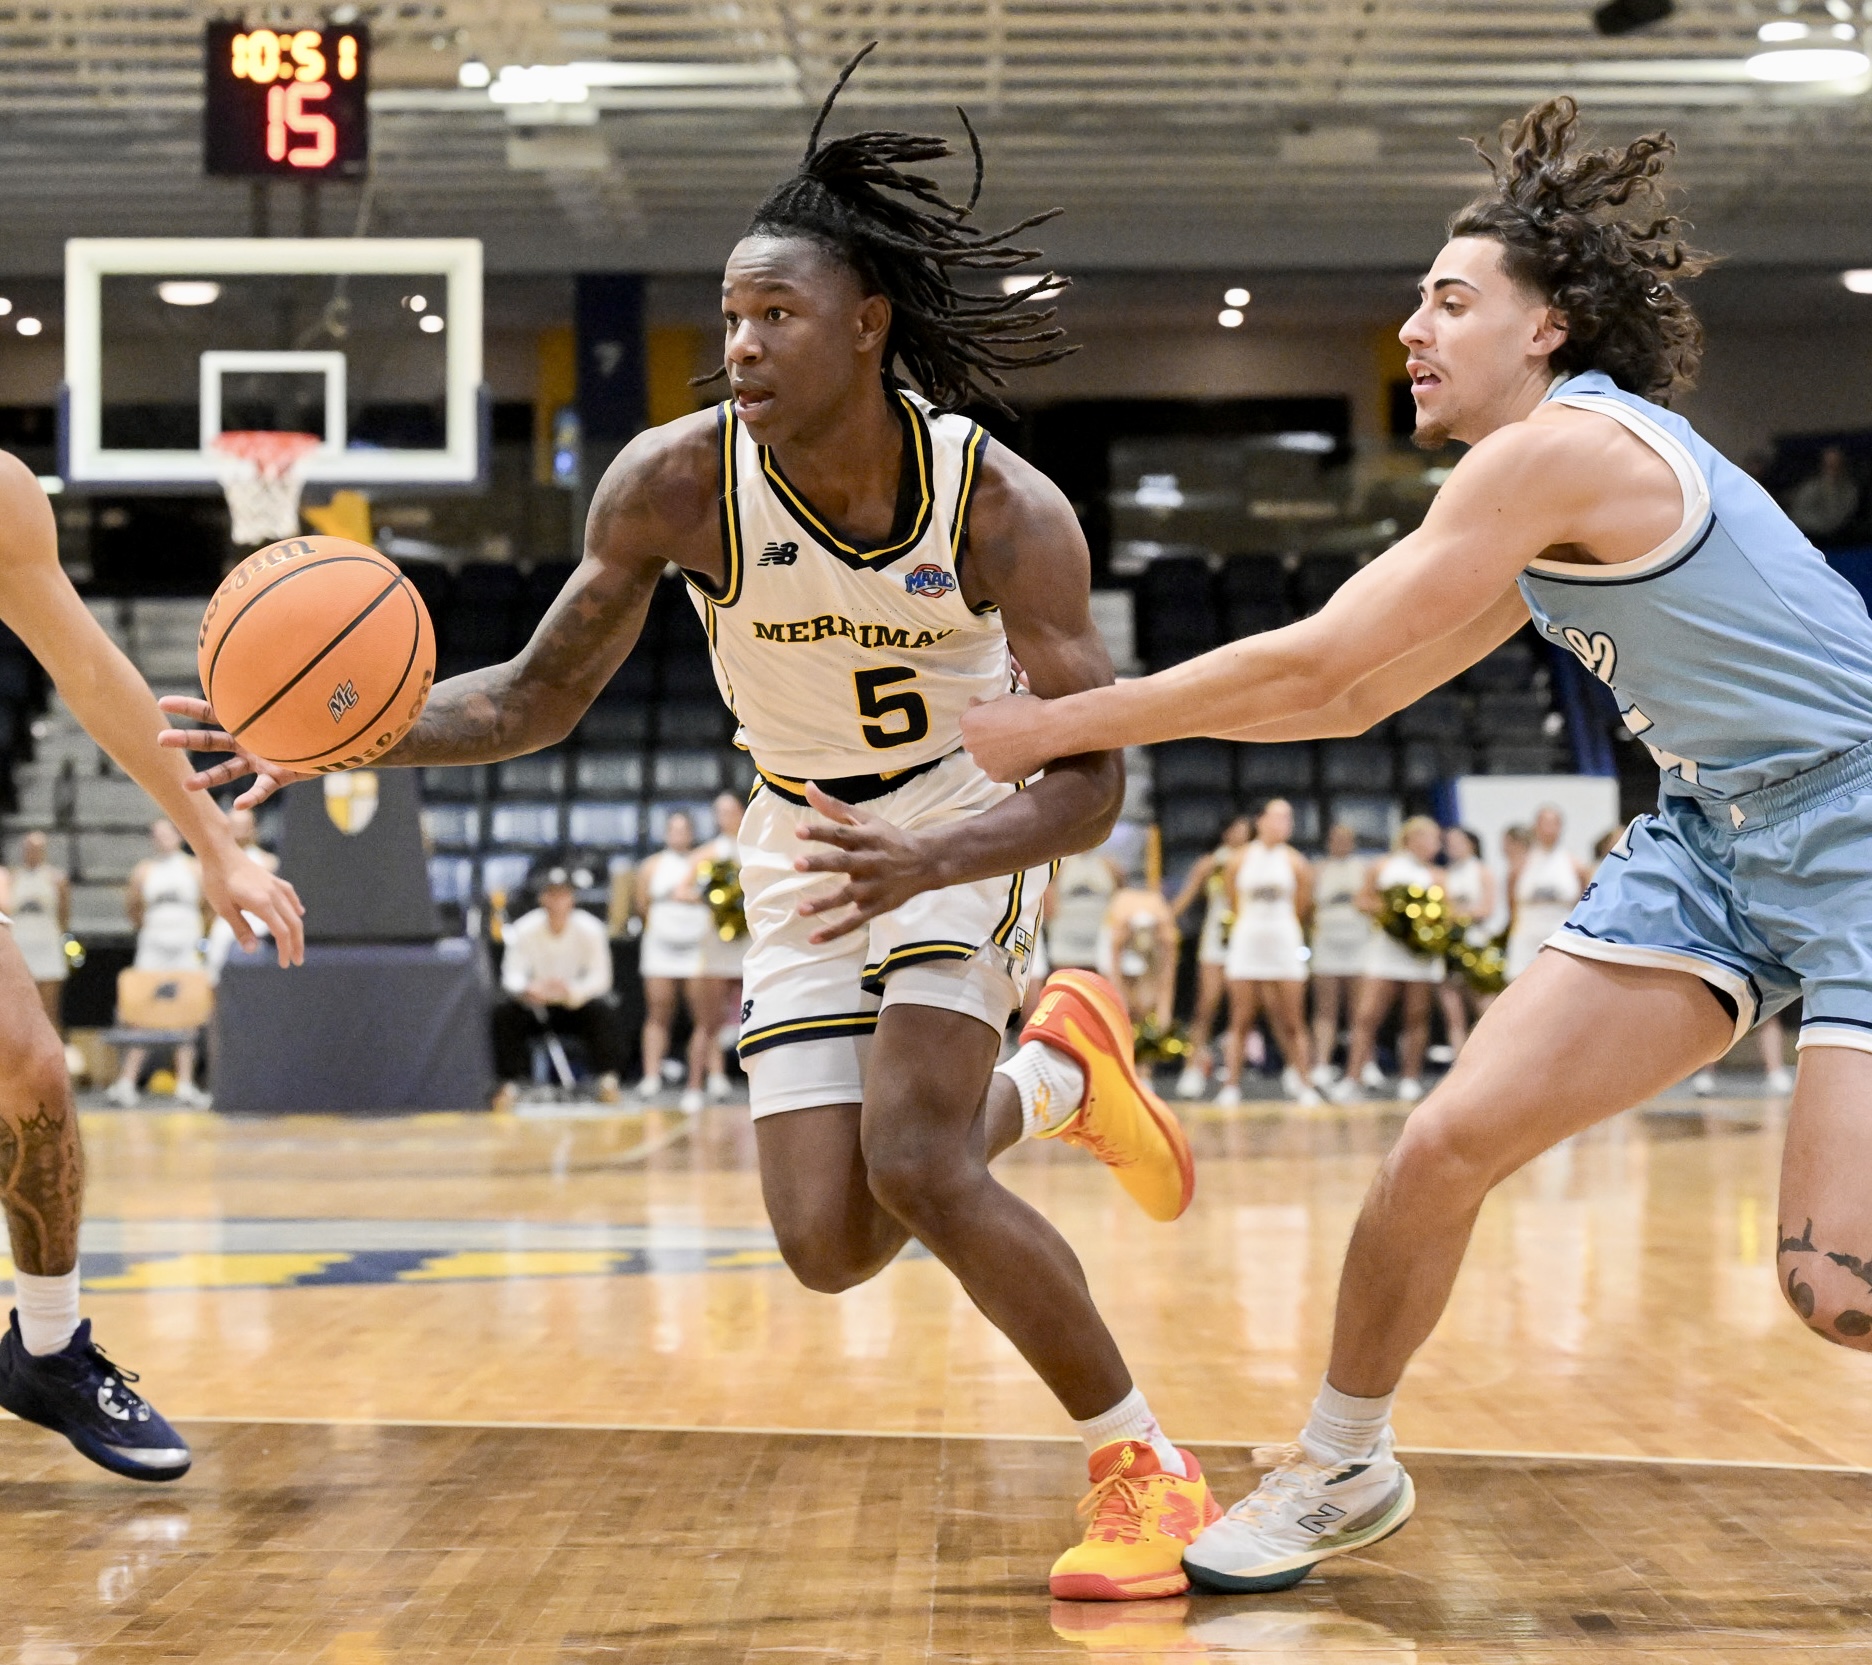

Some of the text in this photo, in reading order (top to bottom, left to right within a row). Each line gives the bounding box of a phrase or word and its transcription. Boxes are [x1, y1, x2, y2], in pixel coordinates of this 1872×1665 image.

[231, 29, 358, 83] 10:51
[267, 80, 337, 168] 15
[905, 571, 956, 595] MAAC
[853, 665, 931, 750] 5
